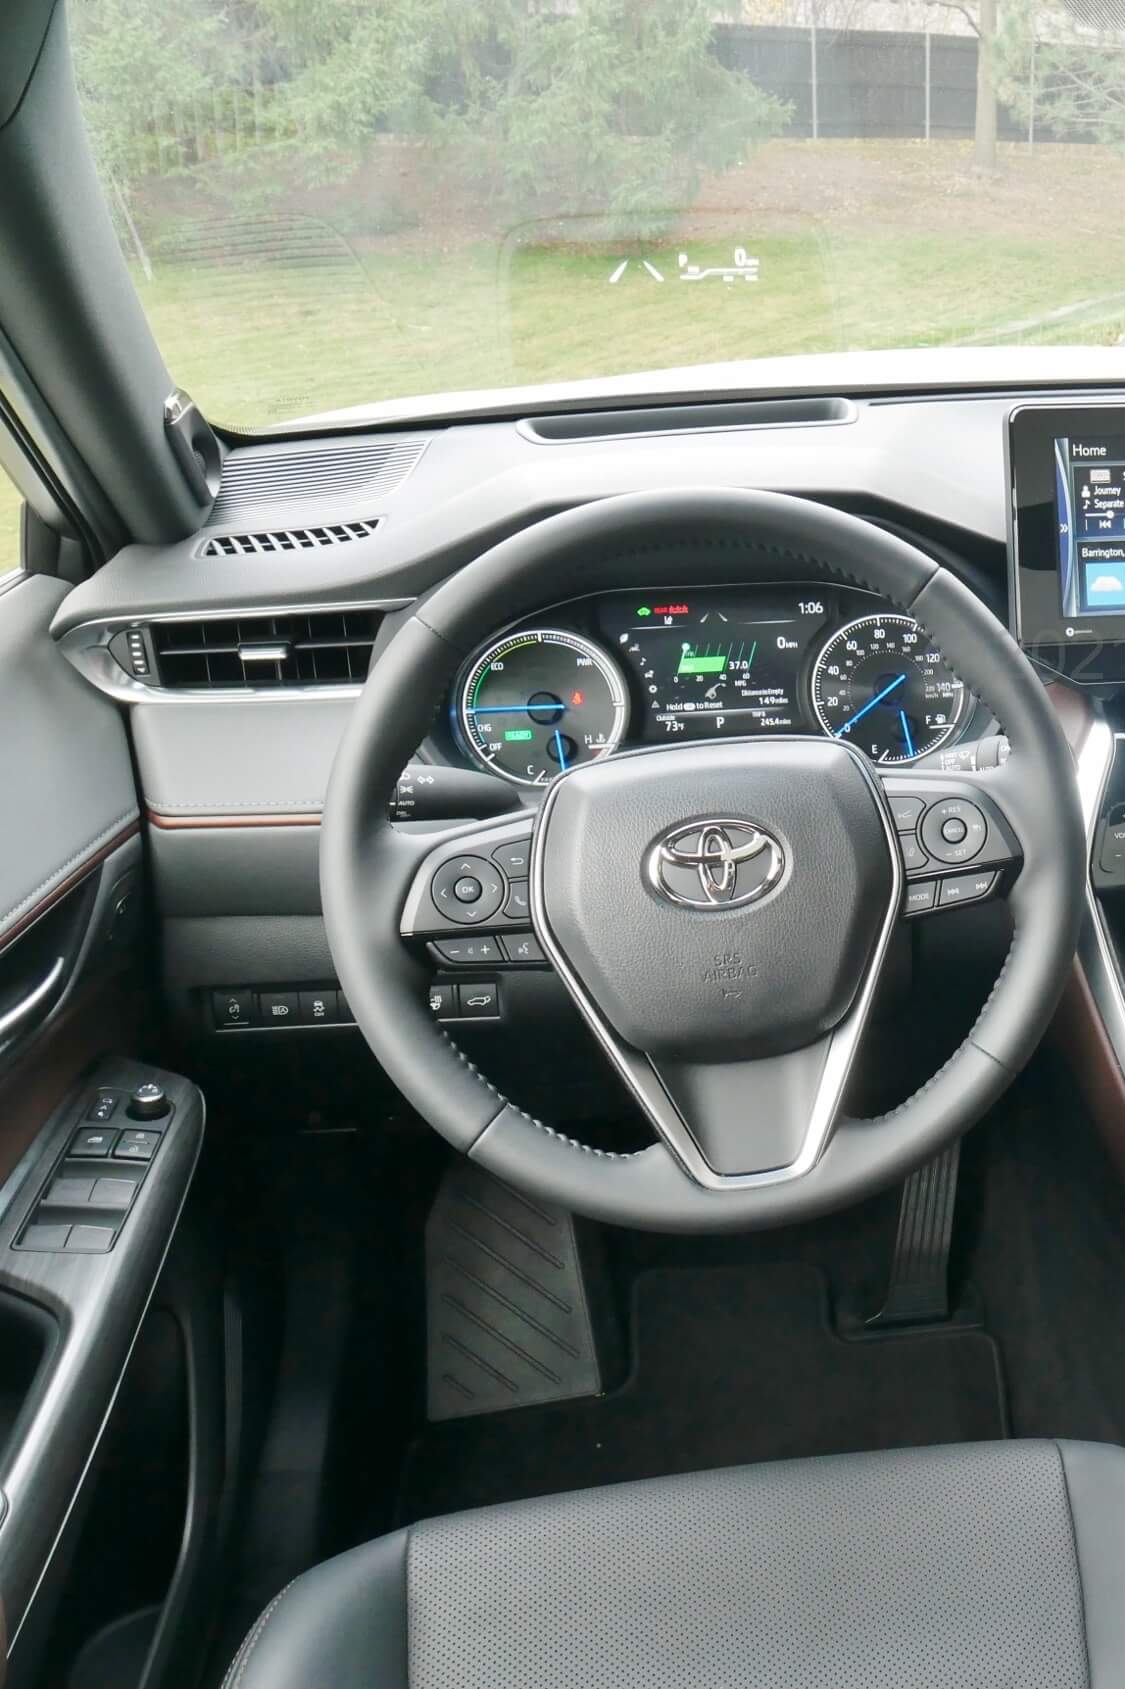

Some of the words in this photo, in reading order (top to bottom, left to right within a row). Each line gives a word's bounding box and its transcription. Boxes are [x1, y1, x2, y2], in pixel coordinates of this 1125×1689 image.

[1072, 444, 1107, 456] Home
[1093, 486, 1121, 496] Journey
[1094, 499, 1123, 509] Separate
[1081, 547, 1125, 558] Barrington,
[798, 601, 824, 615] 1:06
[874, 629, 885, 639] 80
[902, 633, 918, 643] 100
[846, 640, 857, 651] 60
[577, 658, 593, 666] PWR
[925, 653, 940, 663] 120
[490, 663, 504, 671] ECO
[729, 661, 748, 670] 37.0
[827, 666, 839, 675] 40
[936, 682, 951, 692] 140
[827, 697, 838, 706] 20
[716, 717, 725, 728] P
[926, 715, 932, 724] F
[477, 724, 492, 732] CHG
[585, 735, 593, 744] H
[489, 743, 502, 751] OFF
[872, 745, 878, 754] E
[527, 765, 535, 775] C
[462, 885, 474, 893] OK
[714, 953, 742, 967] SRS
[704, 965, 759, 983] AIRBAG
